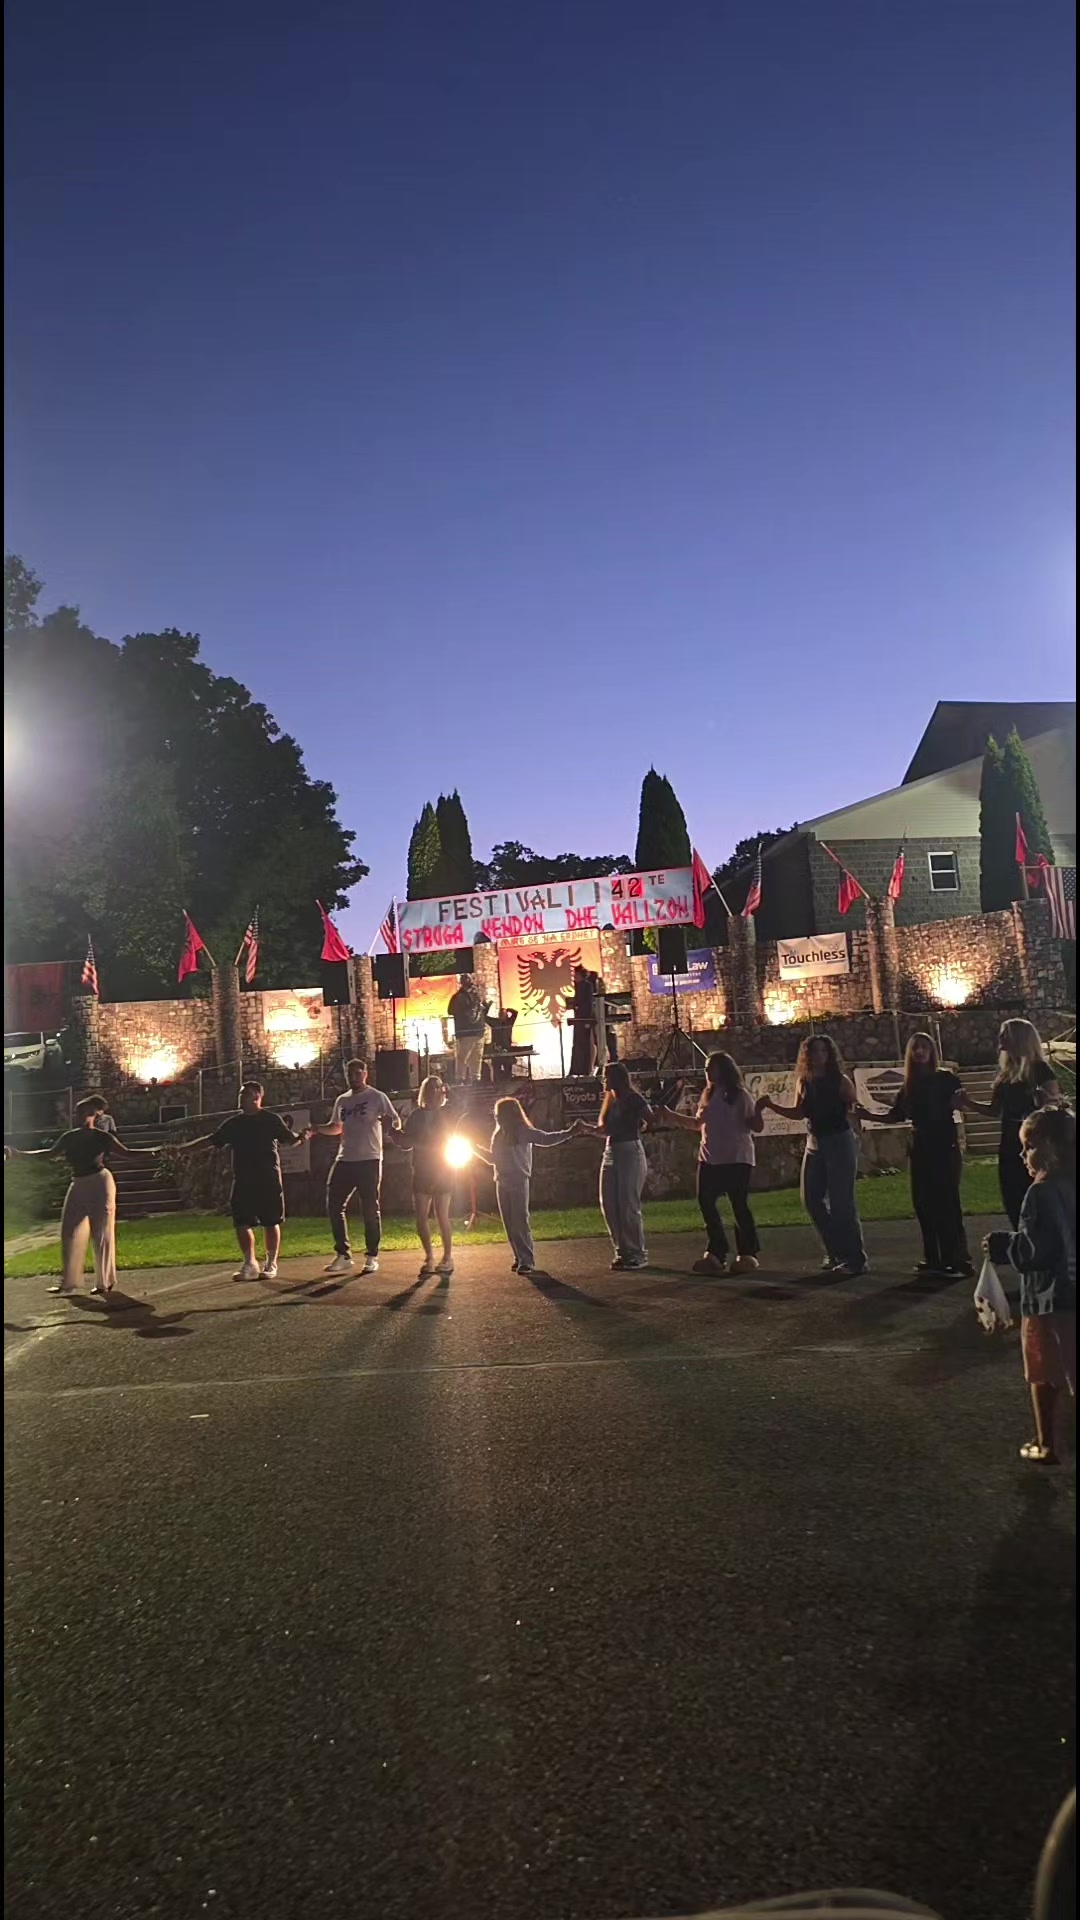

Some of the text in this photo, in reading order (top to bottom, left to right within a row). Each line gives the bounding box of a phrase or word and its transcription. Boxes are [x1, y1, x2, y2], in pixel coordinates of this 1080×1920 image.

[612, 878, 640, 898] 42
[648, 874, 664, 885] TE
[403, 923, 464, 950] STRUGA
[565, 906, 598, 928] DHE
[611, 895, 689, 925] VALLZON
[781, 949, 846, 965] Touchless
[564, 1092, 596, 1105] Toyota
